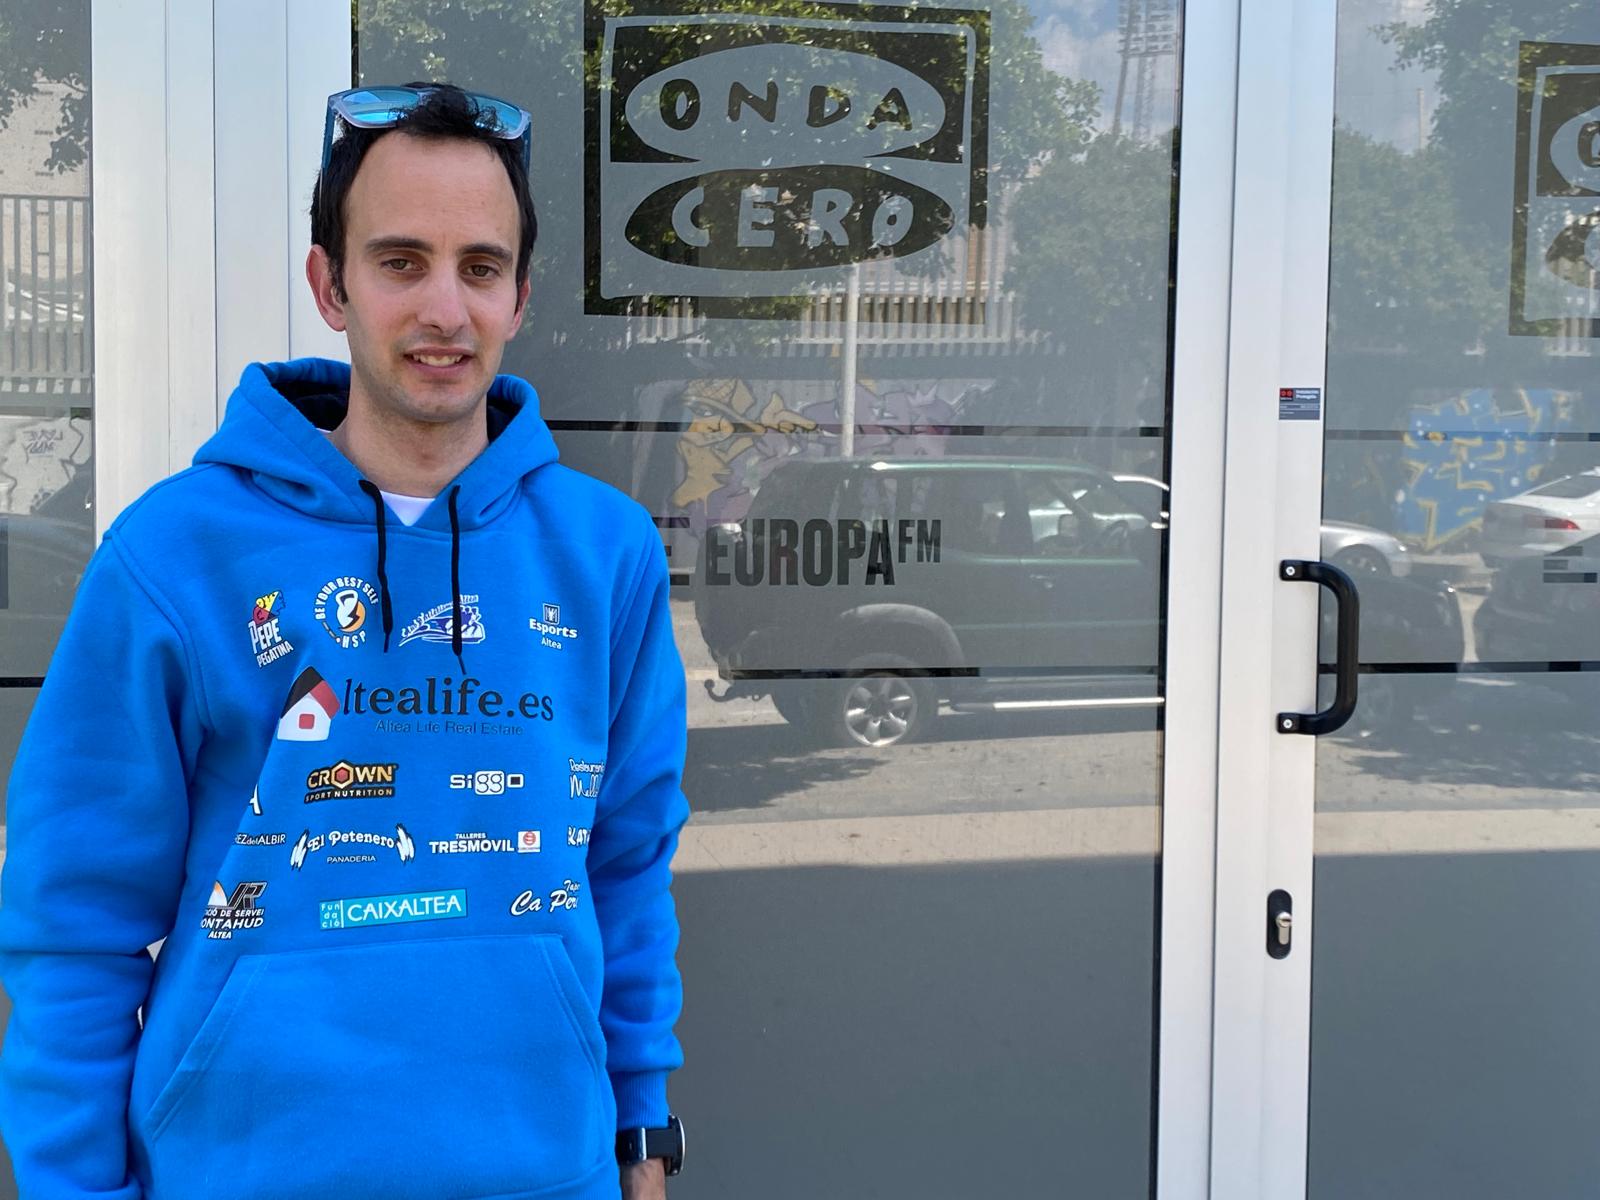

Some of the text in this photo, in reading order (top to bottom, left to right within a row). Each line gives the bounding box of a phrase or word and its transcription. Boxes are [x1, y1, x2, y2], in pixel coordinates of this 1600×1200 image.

[659, 78, 913, 131] ONDA
[671, 185, 914, 248] CERO
[705, 518, 895, 587] EUROPA
[898, 519, 941, 563] FM
[315, 576, 379, 620] BE YOUR BEST SELF
[247, 618, 282, 654] PEPE
[528, 618, 578, 638] Esports
[256, 641, 294, 668] PEGATINA
[540, 637, 562, 649] Altea
[343, 677, 554, 721] ltealife.es
[375, 719, 524, 736] Altea Life Real Estate
[307, 762, 393, 789] CROWN
[305, 788, 393, 803] SPORT NUTRITION
[307, 831, 395, 852] El Petenero
[429, 839, 514, 854] TRESMOVIL
[455, 832, 486, 840] TALLERES
[326, 855, 376, 864] PANADERIA
[346, 895, 462, 922] CAIXALTEA
[509, 890, 542, 916] Ca
[208, 931, 232, 939] ALTEA
